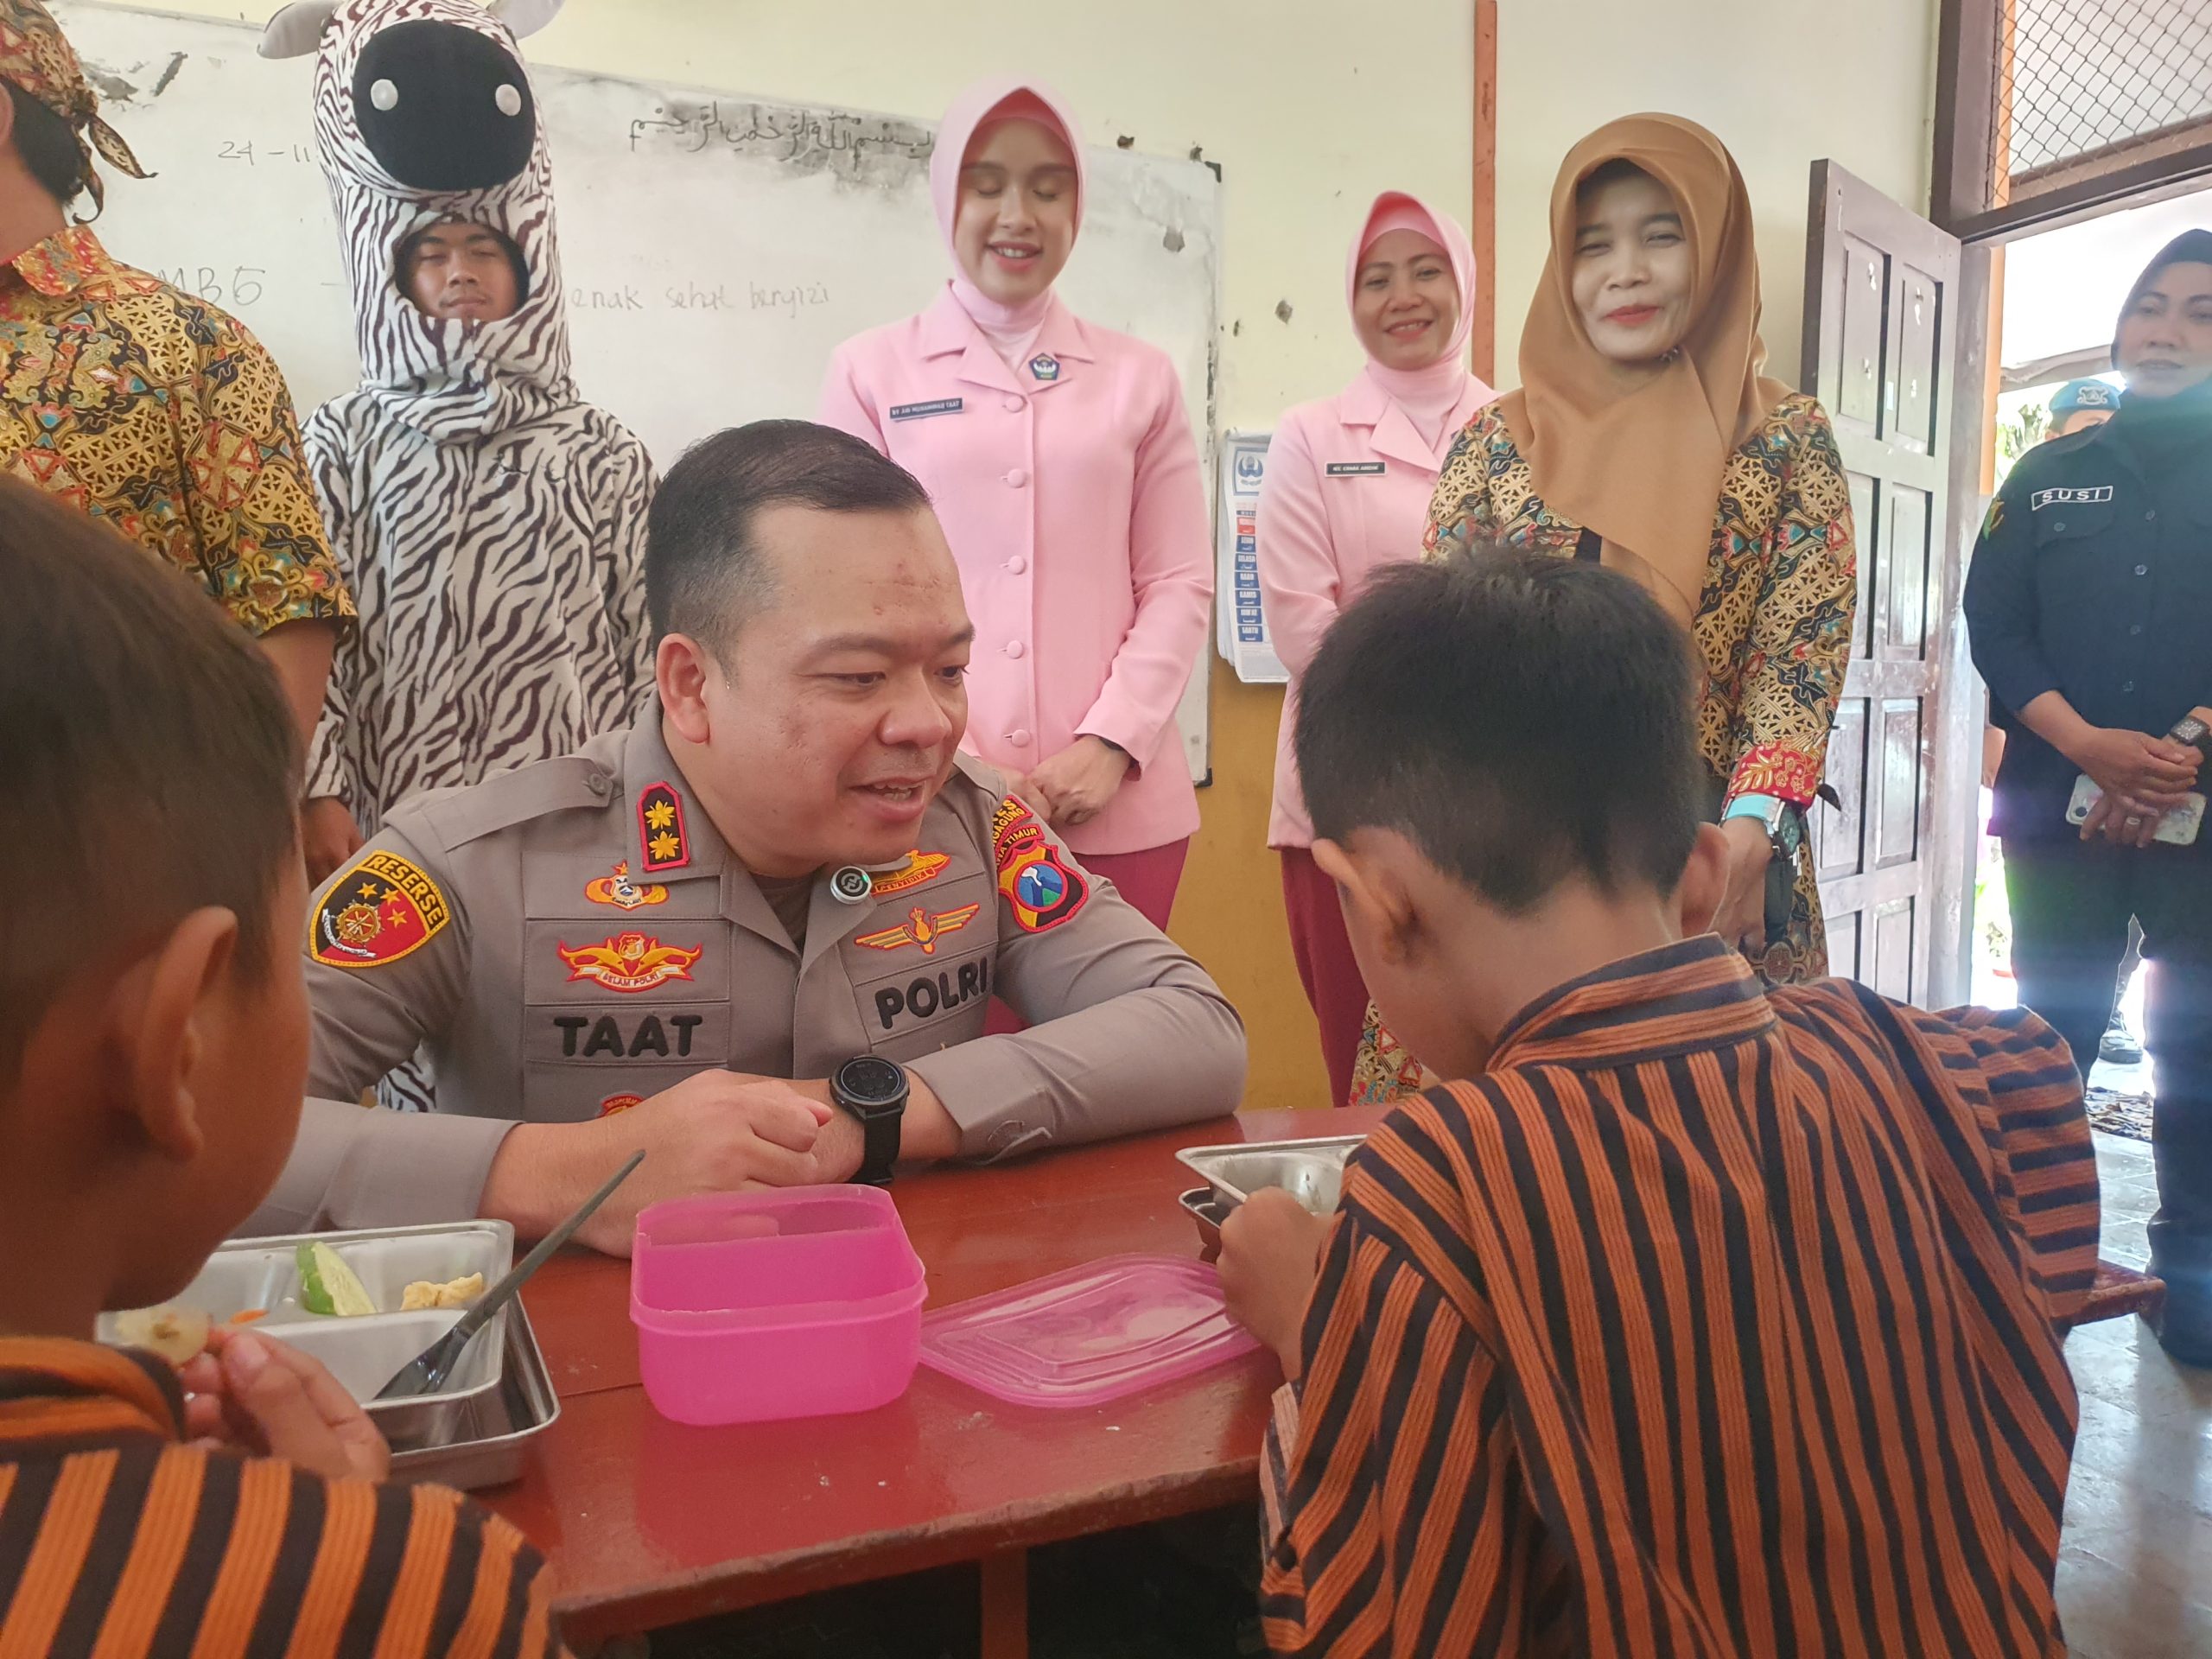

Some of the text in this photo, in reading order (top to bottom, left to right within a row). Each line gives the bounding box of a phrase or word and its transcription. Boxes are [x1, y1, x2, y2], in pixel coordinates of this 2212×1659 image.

[218, 140, 254, 165] 24
[571, 284, 644, 311] enak
[665, 281, 734, 310] sehat
[749, 281, 830, 319] bergizi
[2042, 488, 2101, 503] SUSI
[1005, 827, 1038, 845] TIMUR
[367, 855, 442, 925] RESERSE
[874, 957, 988, 1029] POLRI
[553, 1014, 703, 1057] TAAT
